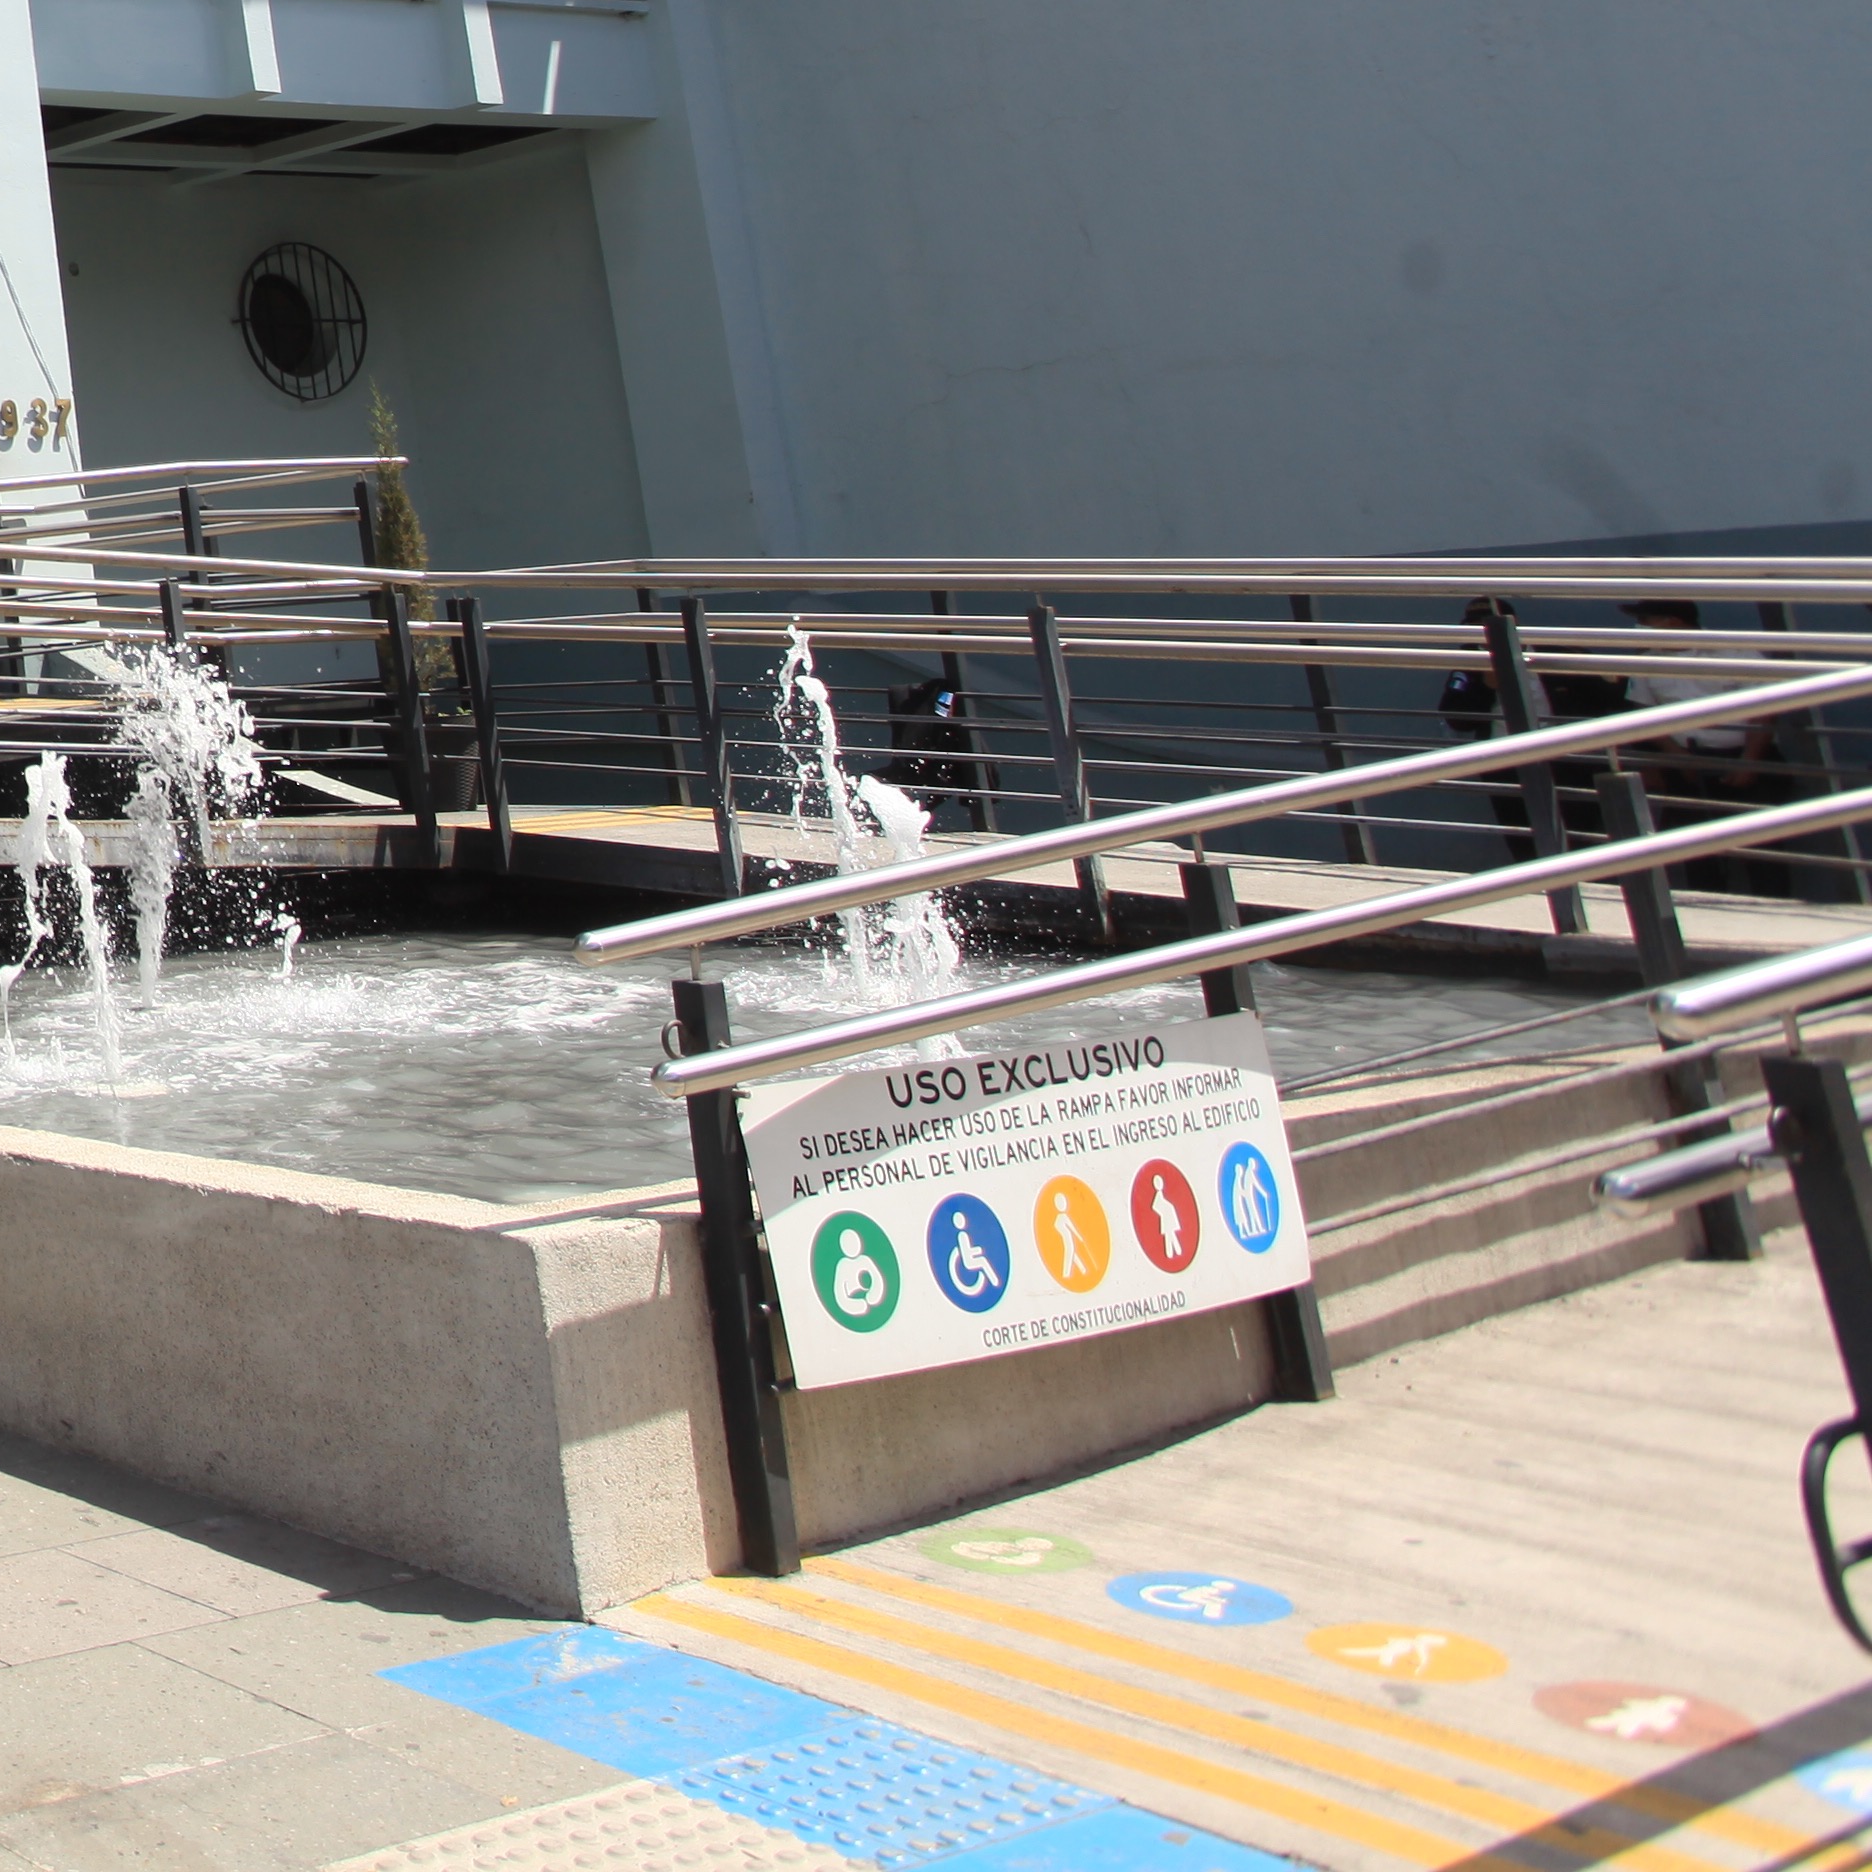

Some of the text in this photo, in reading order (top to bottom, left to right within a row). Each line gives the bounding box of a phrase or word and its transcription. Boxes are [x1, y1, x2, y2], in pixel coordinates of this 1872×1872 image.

[1, 398, 71, 437] 937
[886, 1035, 1165, 1108] USO EXCLUSIVO
[792, 1098, 1261, 1199] AL PERSONAL DE VIGILANCIA EN EL INGRESO AL EDIFICIO
[800, 1067, 1242, 1160] SI DESEA HACER USO DE LA RAMPA FAVOR INFORMAR
[982, 1290, 1185, 1348] CORTE DE CONSTITUCIONALIDAD
